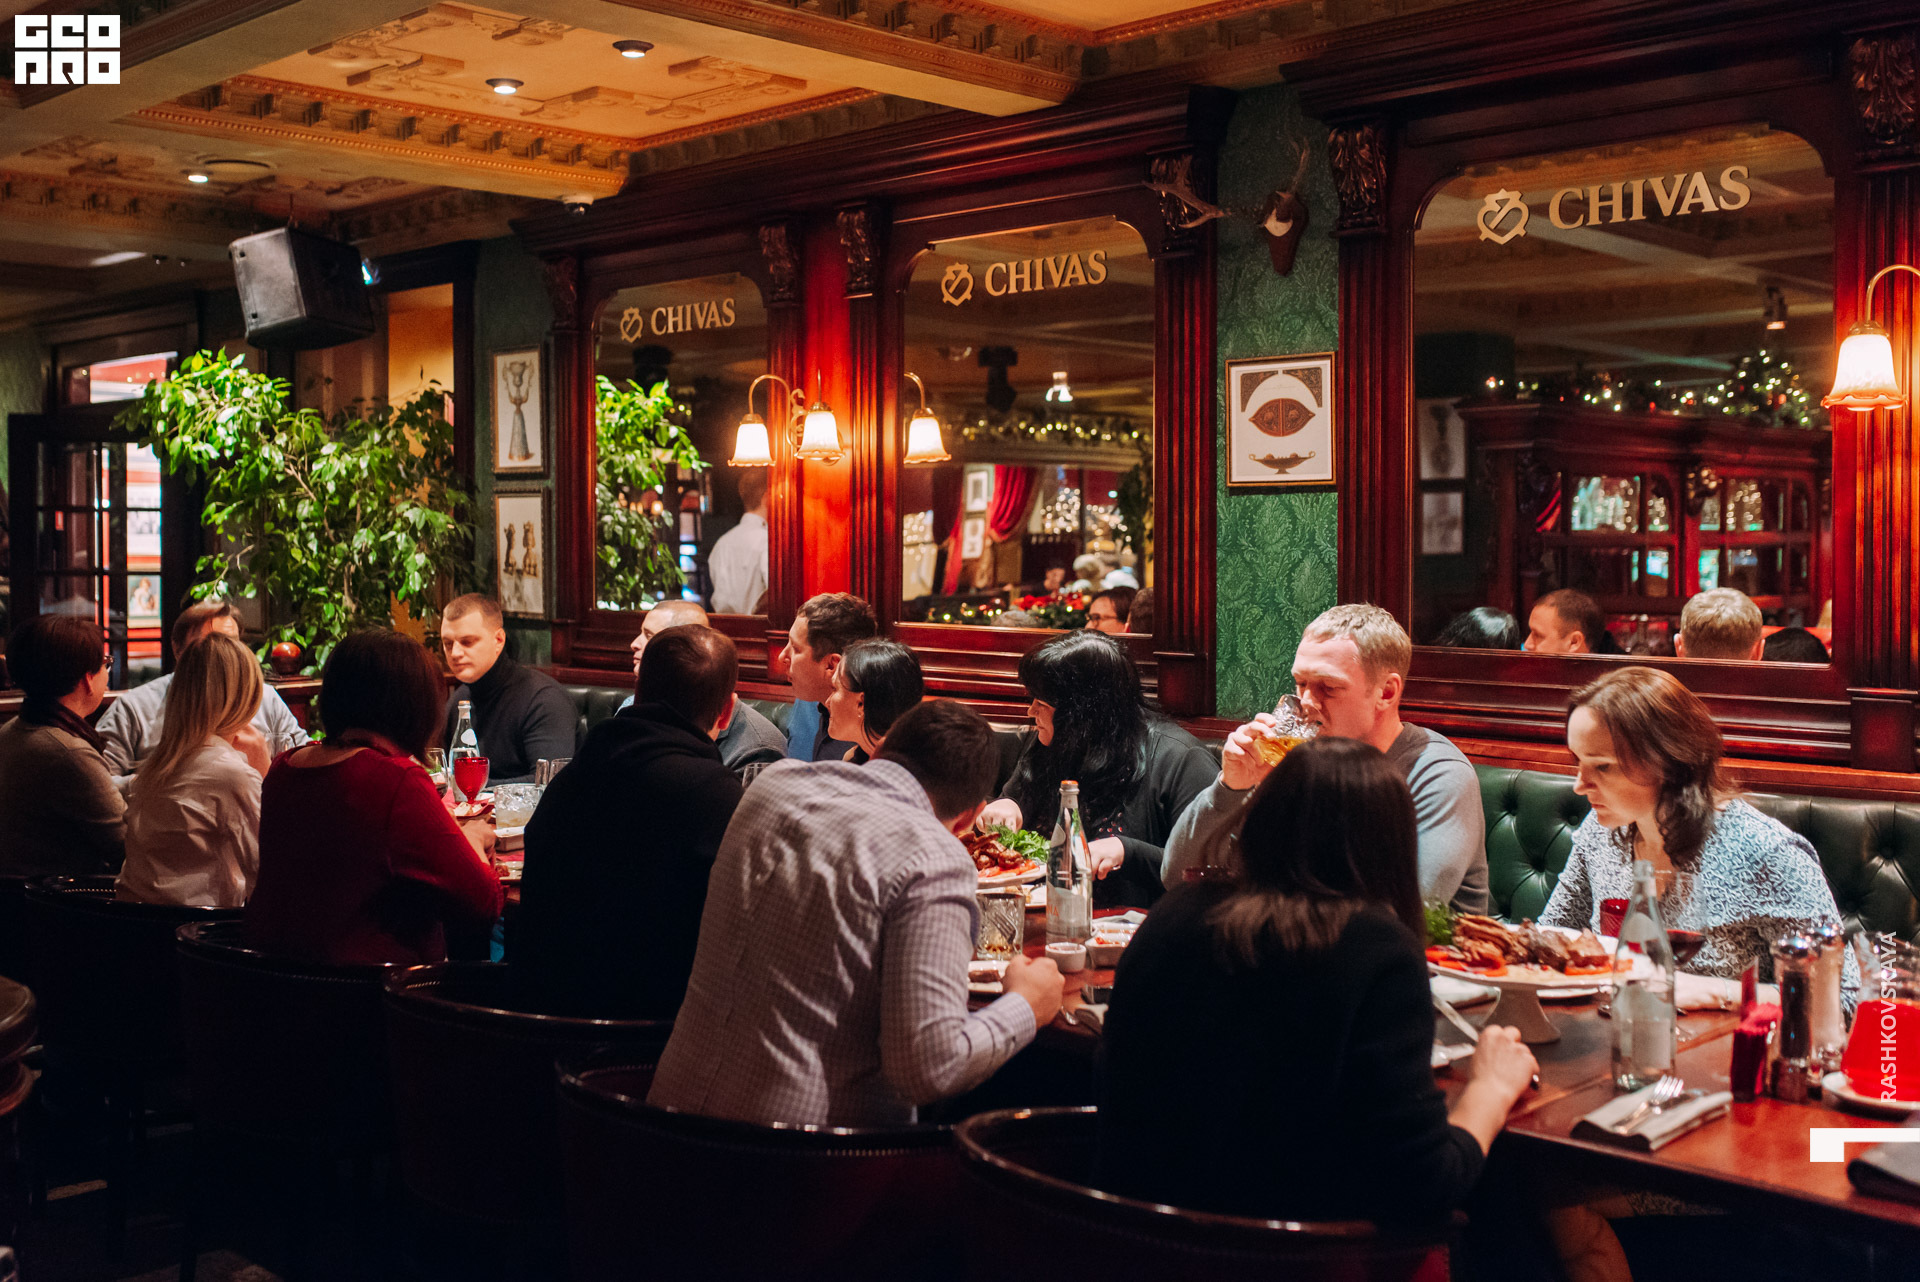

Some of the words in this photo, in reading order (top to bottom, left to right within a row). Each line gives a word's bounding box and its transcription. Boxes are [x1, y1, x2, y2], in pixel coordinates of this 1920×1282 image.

[1549, 166, 1751, 229] CHIVAS
[985, 250, 1107, 297] CHIVAS
[650, 298, 736, 336] CHIVAS
